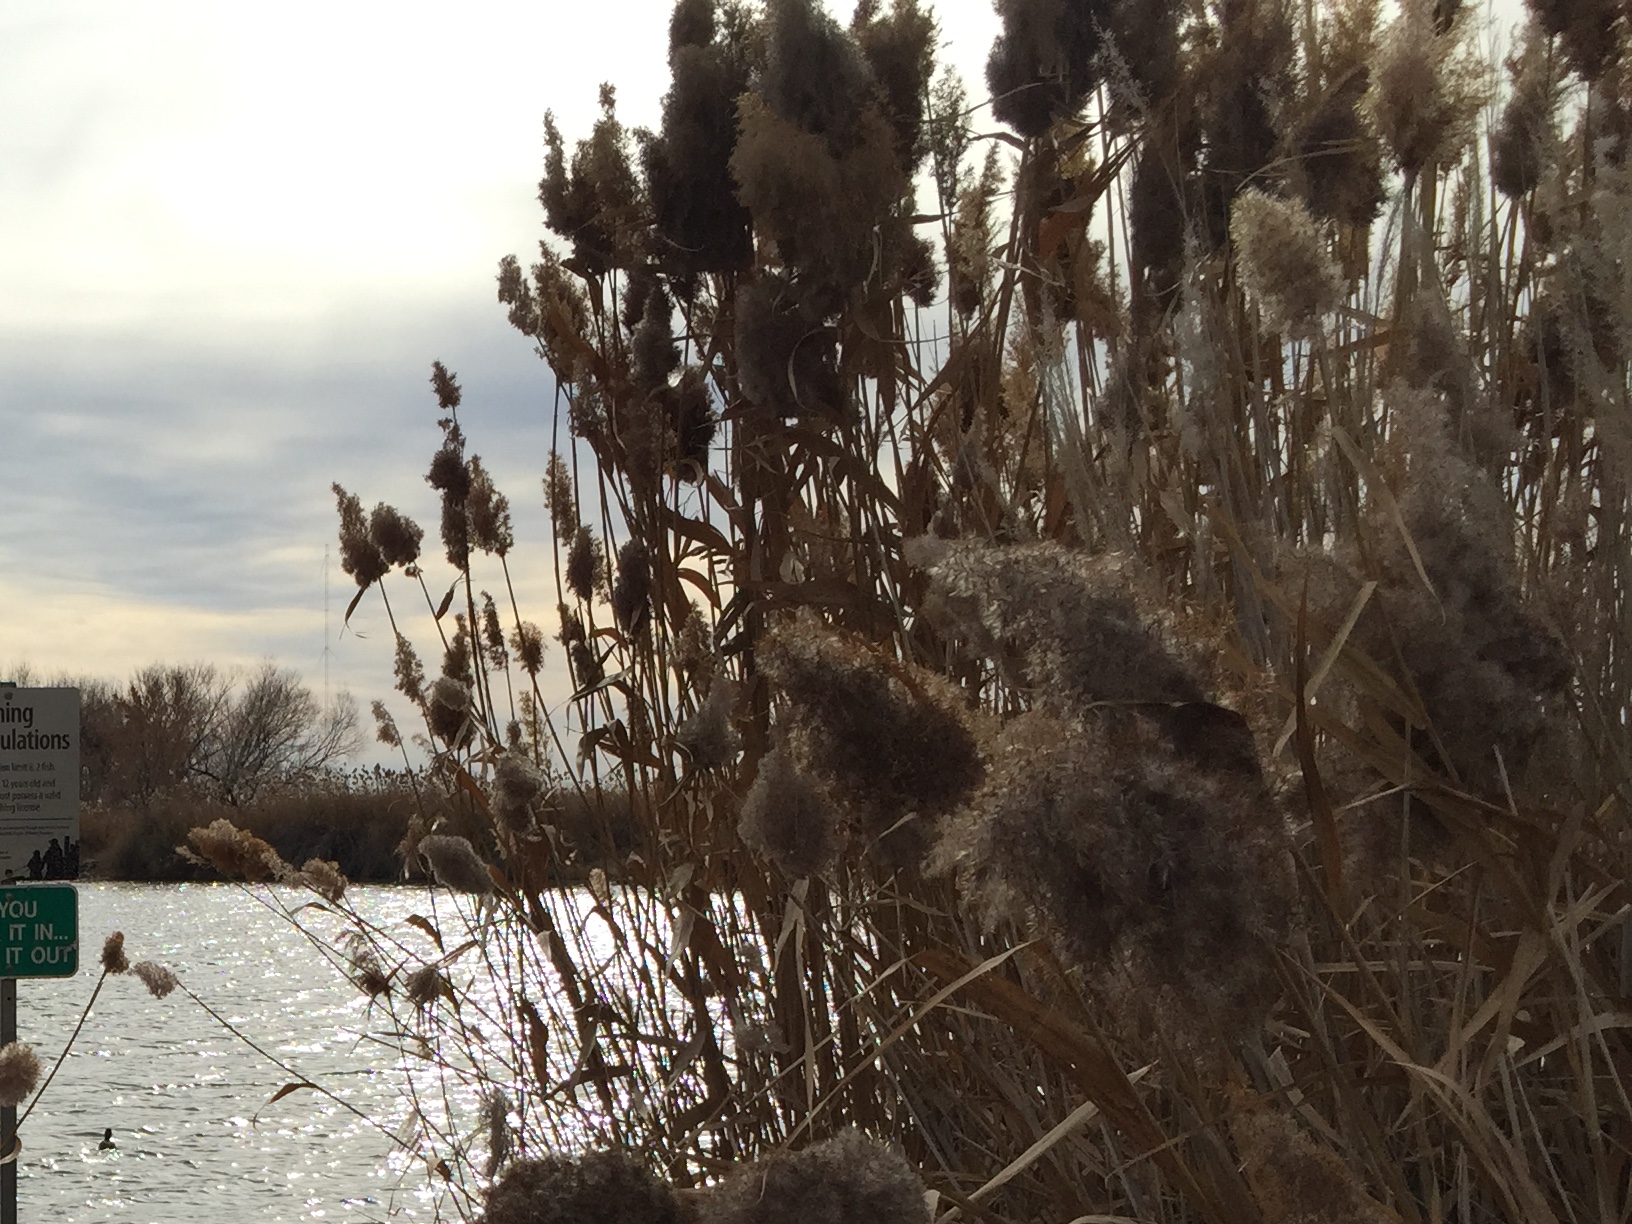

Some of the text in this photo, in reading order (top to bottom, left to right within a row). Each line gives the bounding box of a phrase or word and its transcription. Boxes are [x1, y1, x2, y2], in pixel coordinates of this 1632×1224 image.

[9, 924, 26, 941] IT
[34, 923, 69, 941] IN...
[5, 947, 23, 965] IT
[31, 947, 72, 964] OUT
